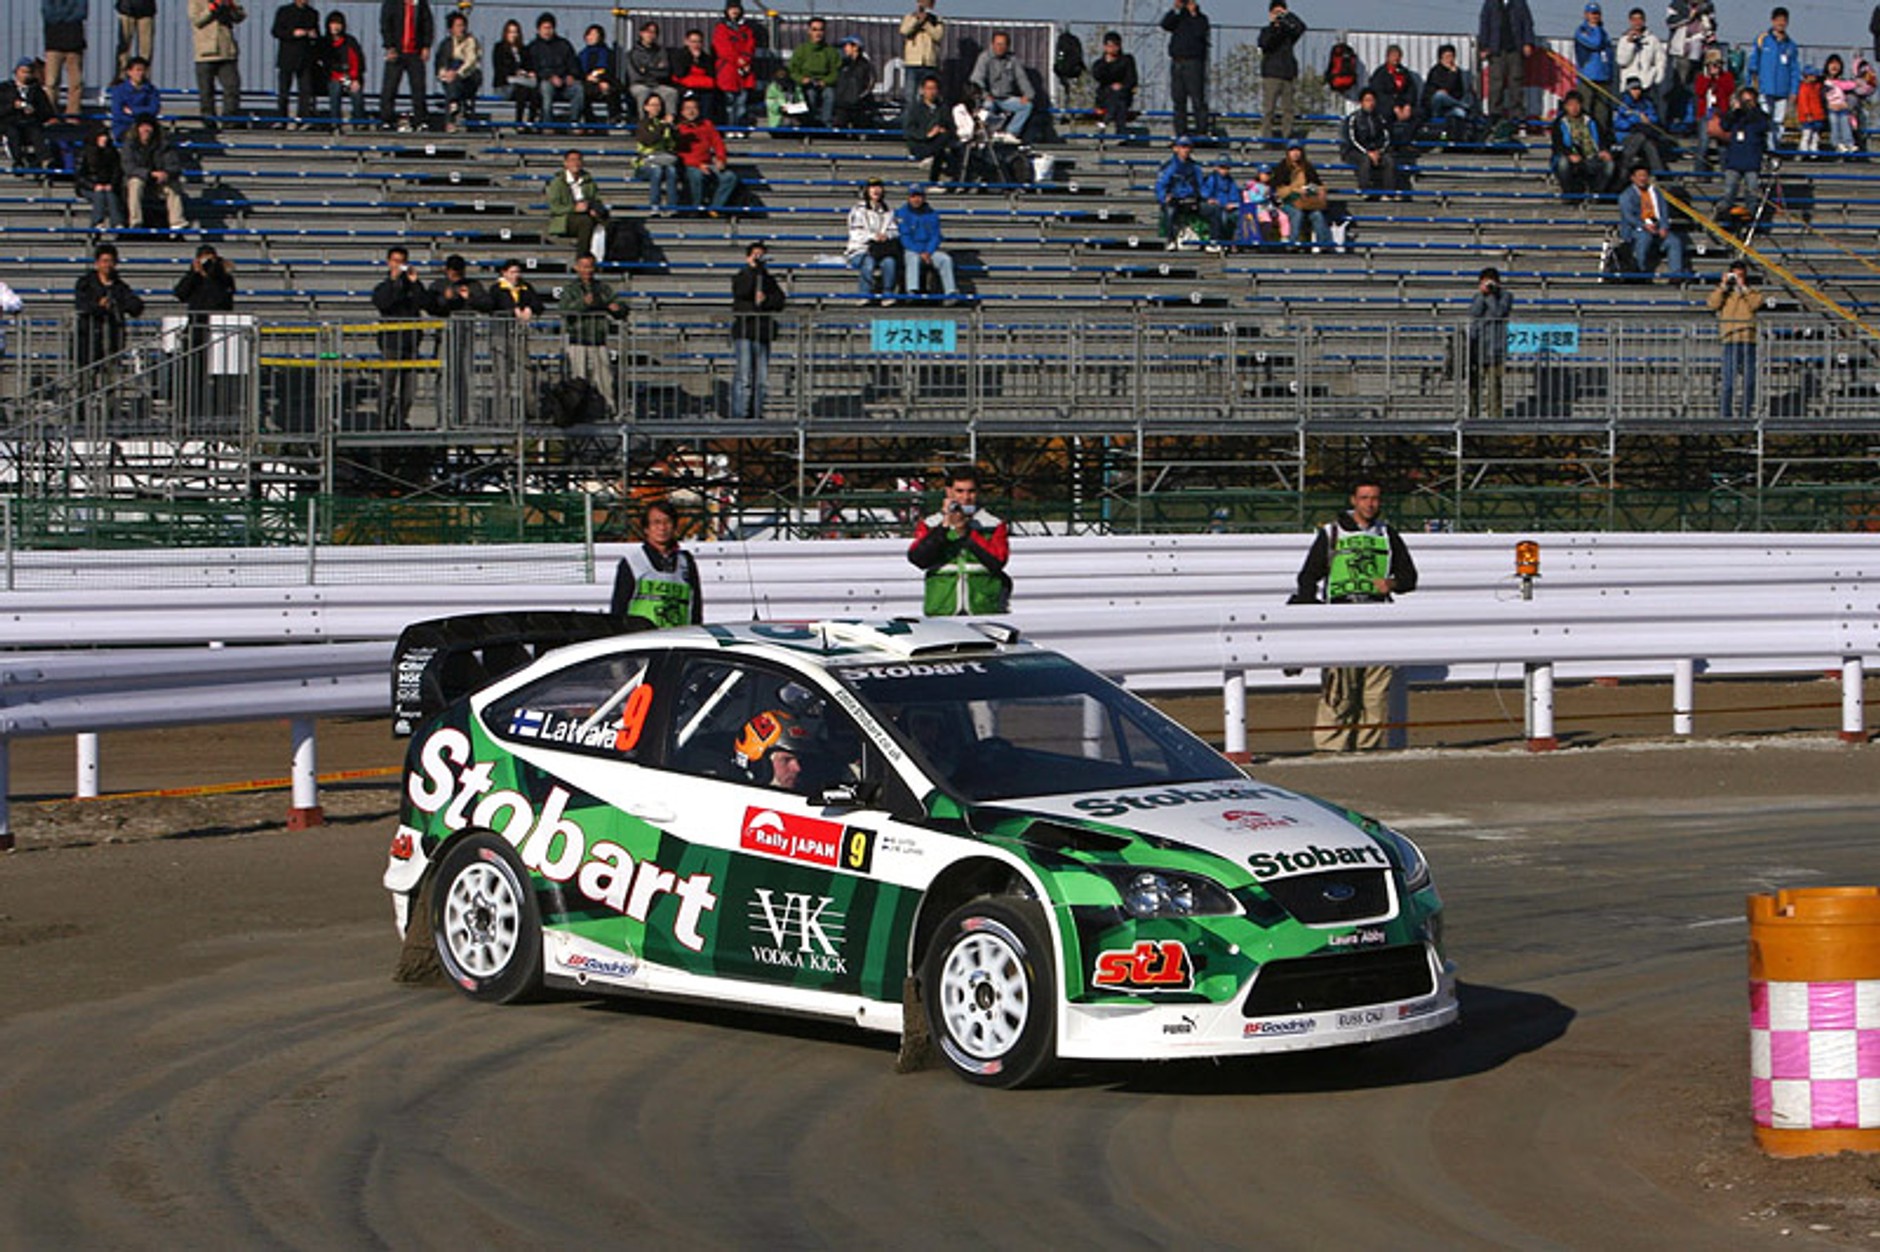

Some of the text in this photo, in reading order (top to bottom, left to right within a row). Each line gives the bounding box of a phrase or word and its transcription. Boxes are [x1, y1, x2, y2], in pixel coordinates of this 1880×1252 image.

[840, 661, 988, 680] Stobart
[615, 683, 654, 752] 9
[1072, 787, 1300, 818] Stobart
[408, 727, 717, 952] Stobart
[756, 829, 836, 857] Rally JAPAN
[850, 832, 867, 867] 9
[1248, 845, 1386, 878] Stobart
[754, 888, 840, 956] VK
[752, 946, 848, 974] VODKA KICK
[1096, 942, 1185, 985] st1
[1243, 1018, 1317, 1035] BFGoodrich
